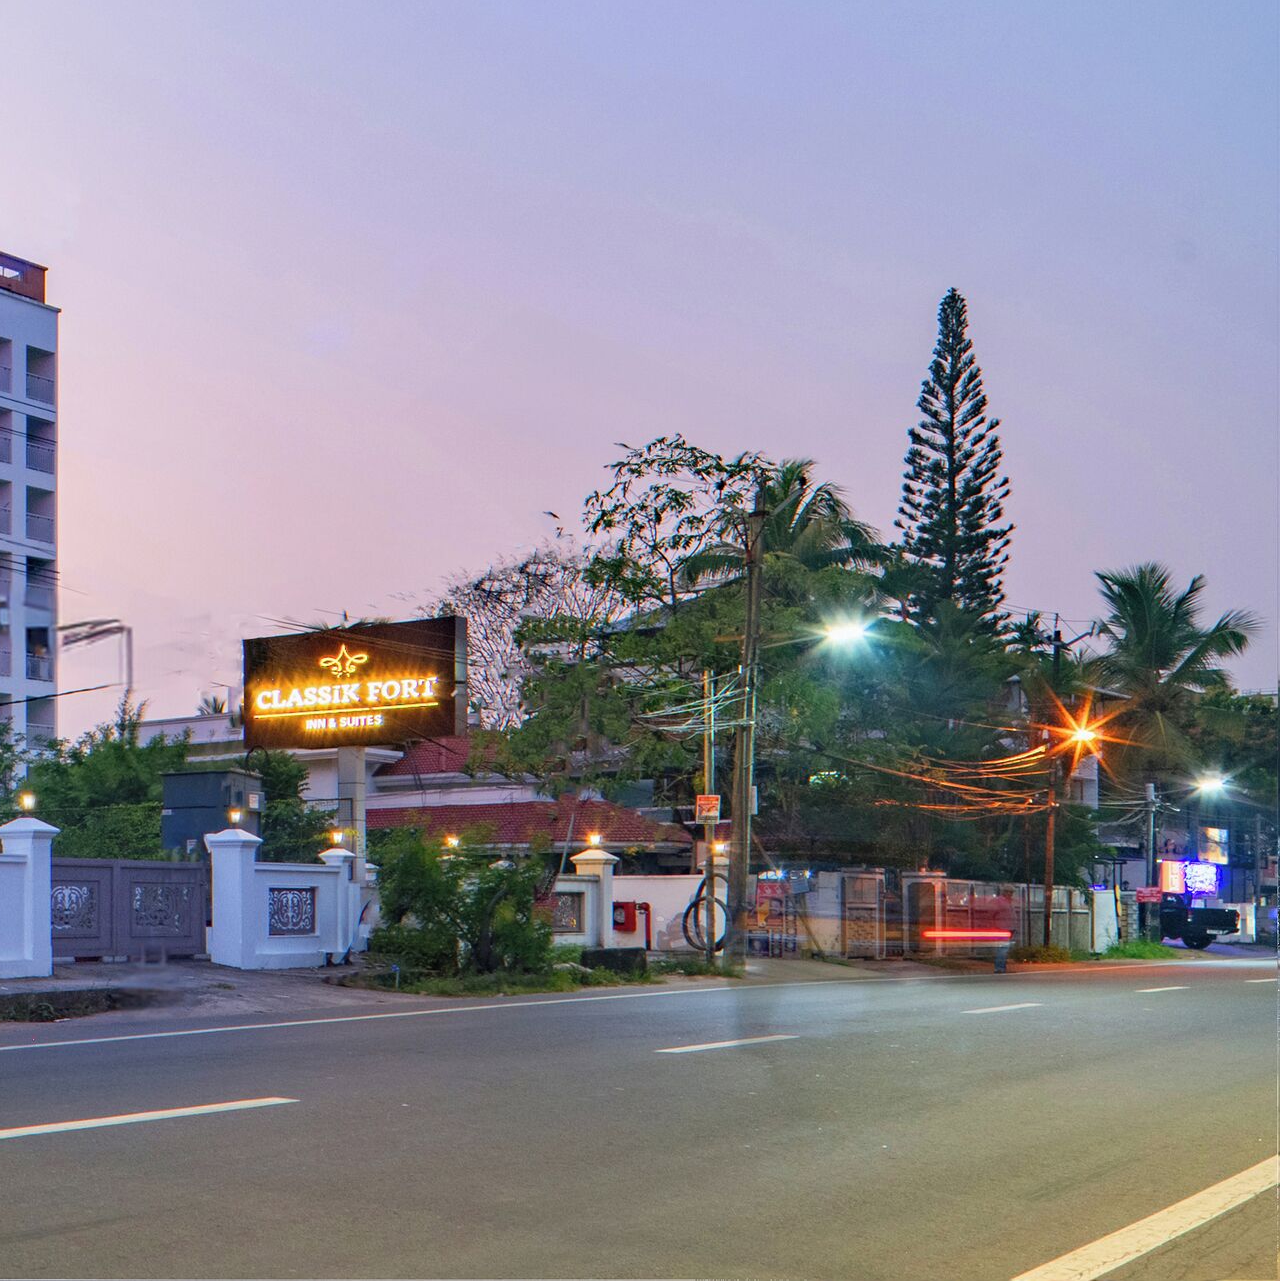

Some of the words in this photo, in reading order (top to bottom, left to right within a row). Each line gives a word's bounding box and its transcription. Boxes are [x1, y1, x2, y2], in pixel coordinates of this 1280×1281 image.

[367, 676, 438, 702] FORT
[306, 718, 326, 730] INN
[328, 717, 336, 729] &
[340, 714, 383, 728] SUITES
